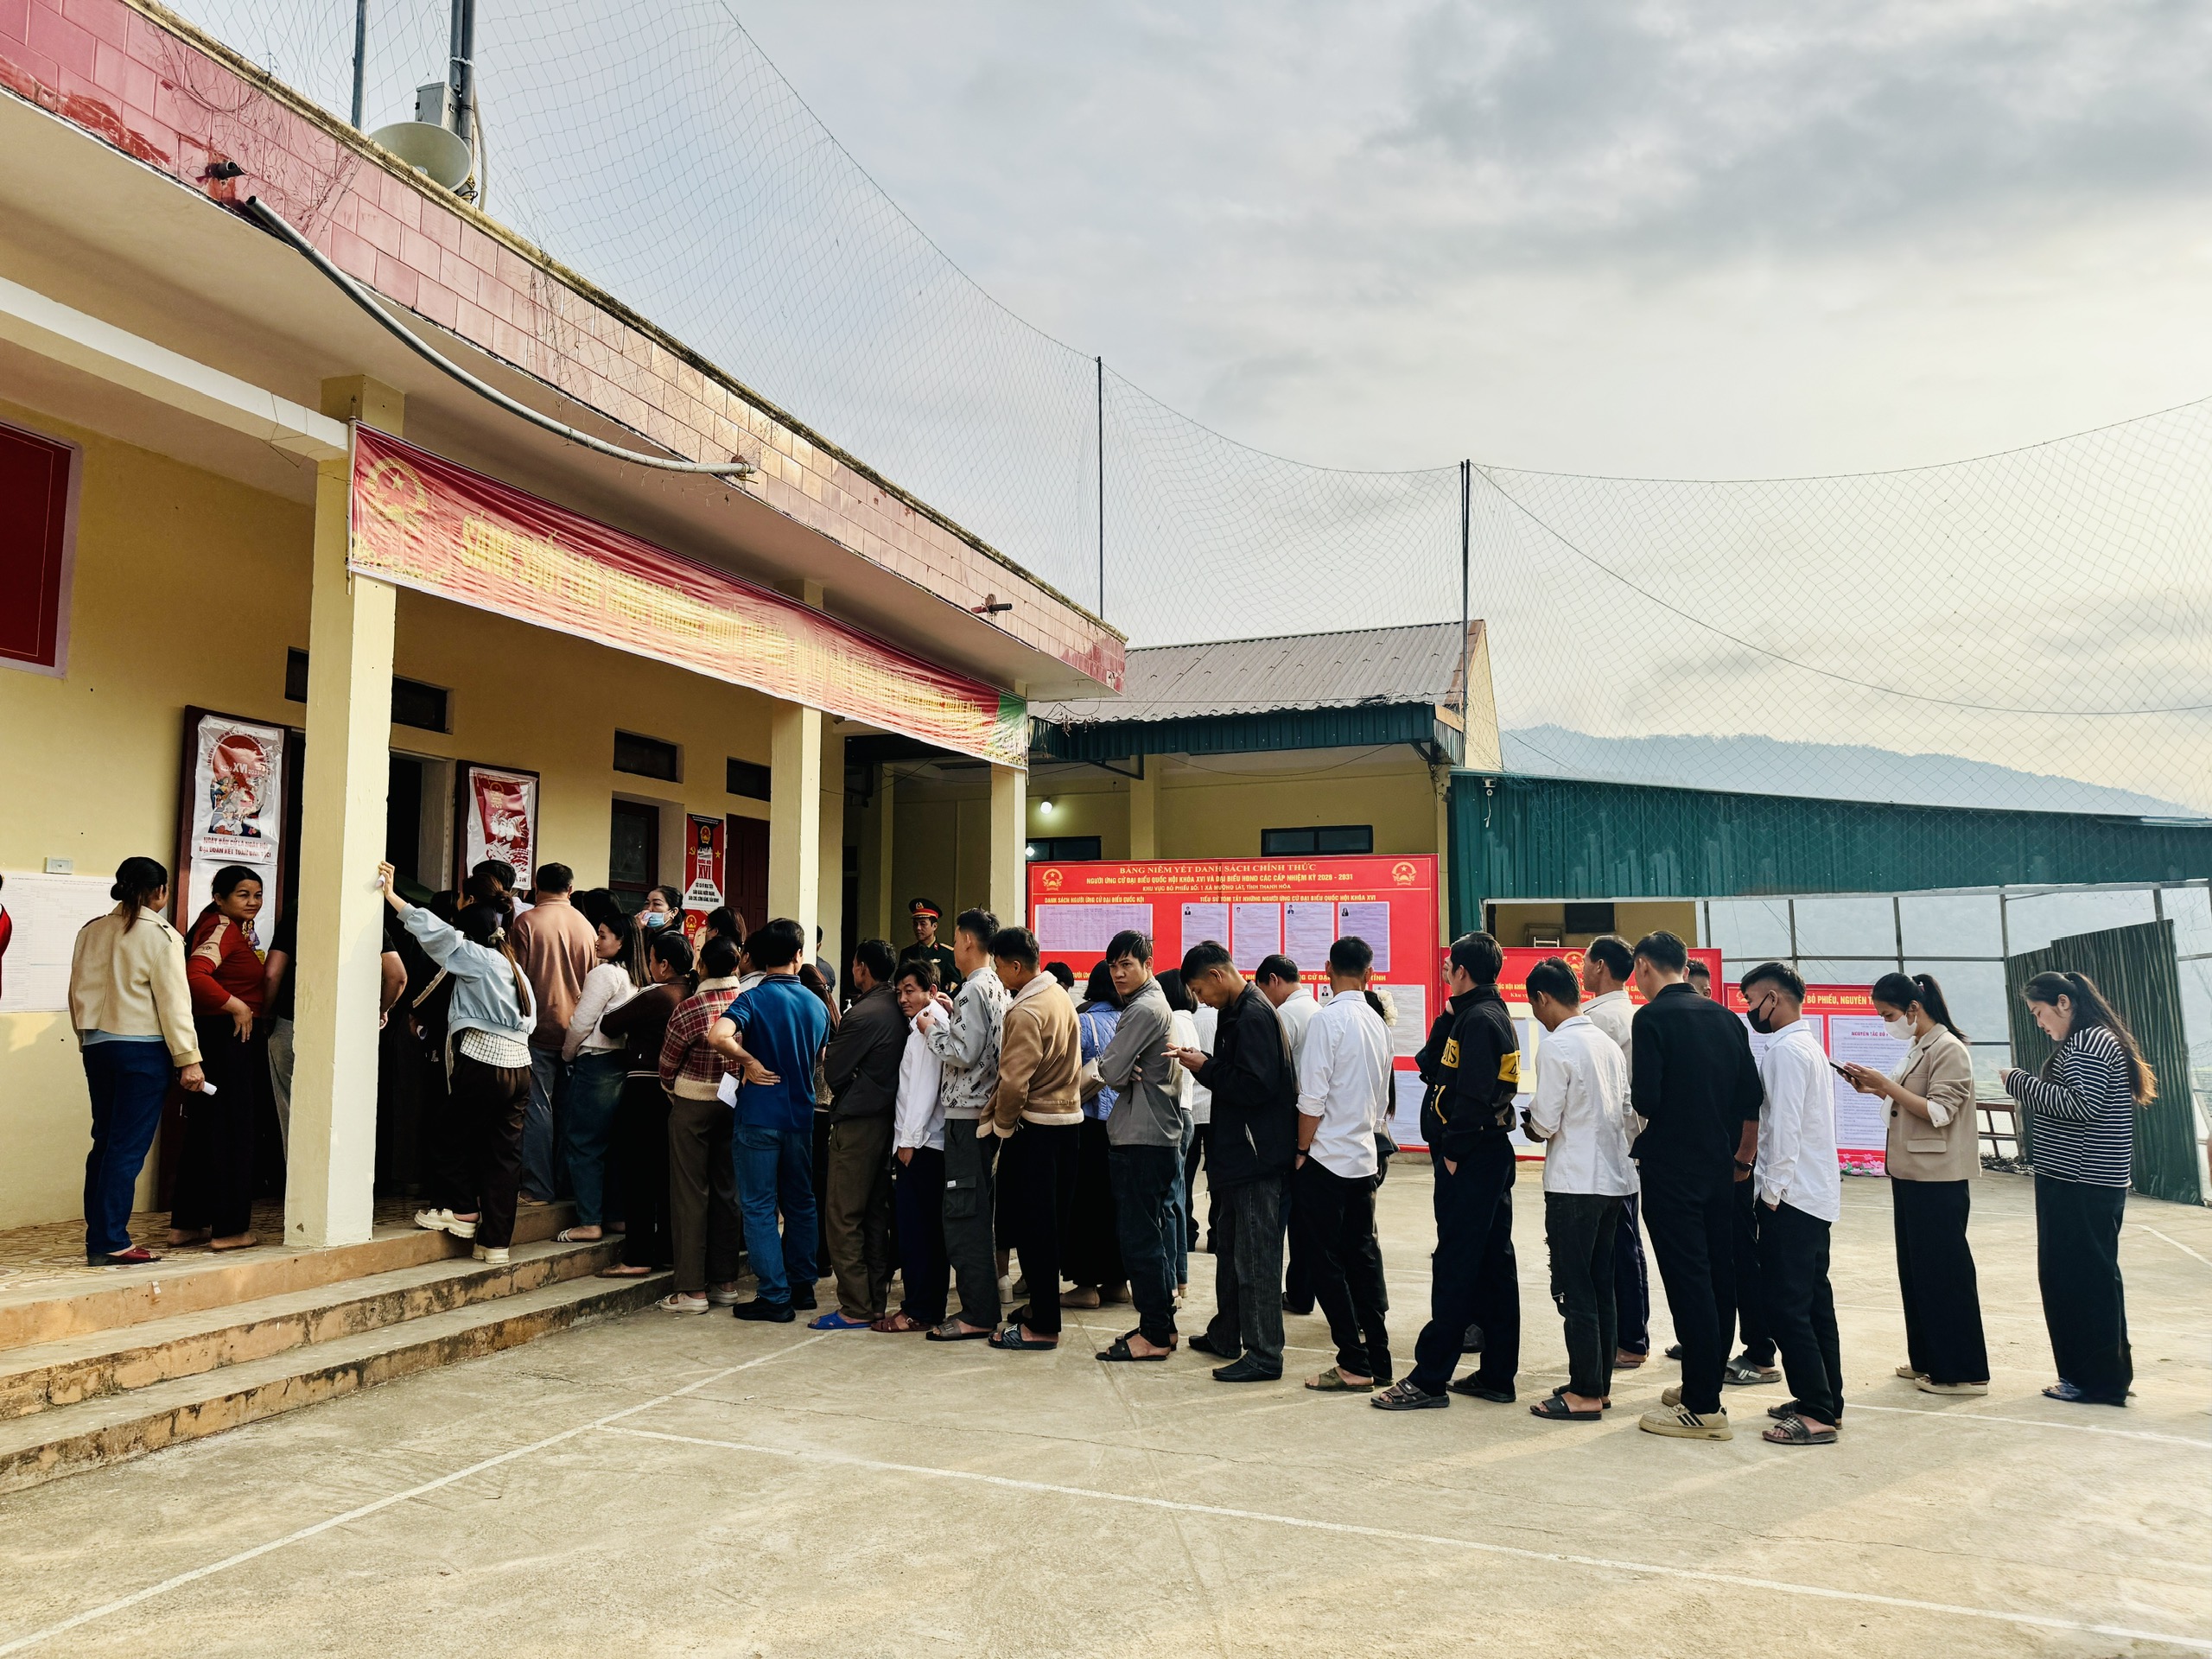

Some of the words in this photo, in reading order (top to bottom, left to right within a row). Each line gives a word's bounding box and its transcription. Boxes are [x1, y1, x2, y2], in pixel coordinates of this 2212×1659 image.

[233, 762, 248, 773] XVI
[698, 864, 711, 880] XVI
[1147, 865, 1173, 874] NIÊM
[1195, 865, 1222, 874] DANH
[1224, 864, 1250, 873] SÁCH
[1253, 863, 1285, 872] CHÍNH
[1287, 862, 1317, 871] THỨC
[1840, 995, 1867, 1005] NGUYÊN
